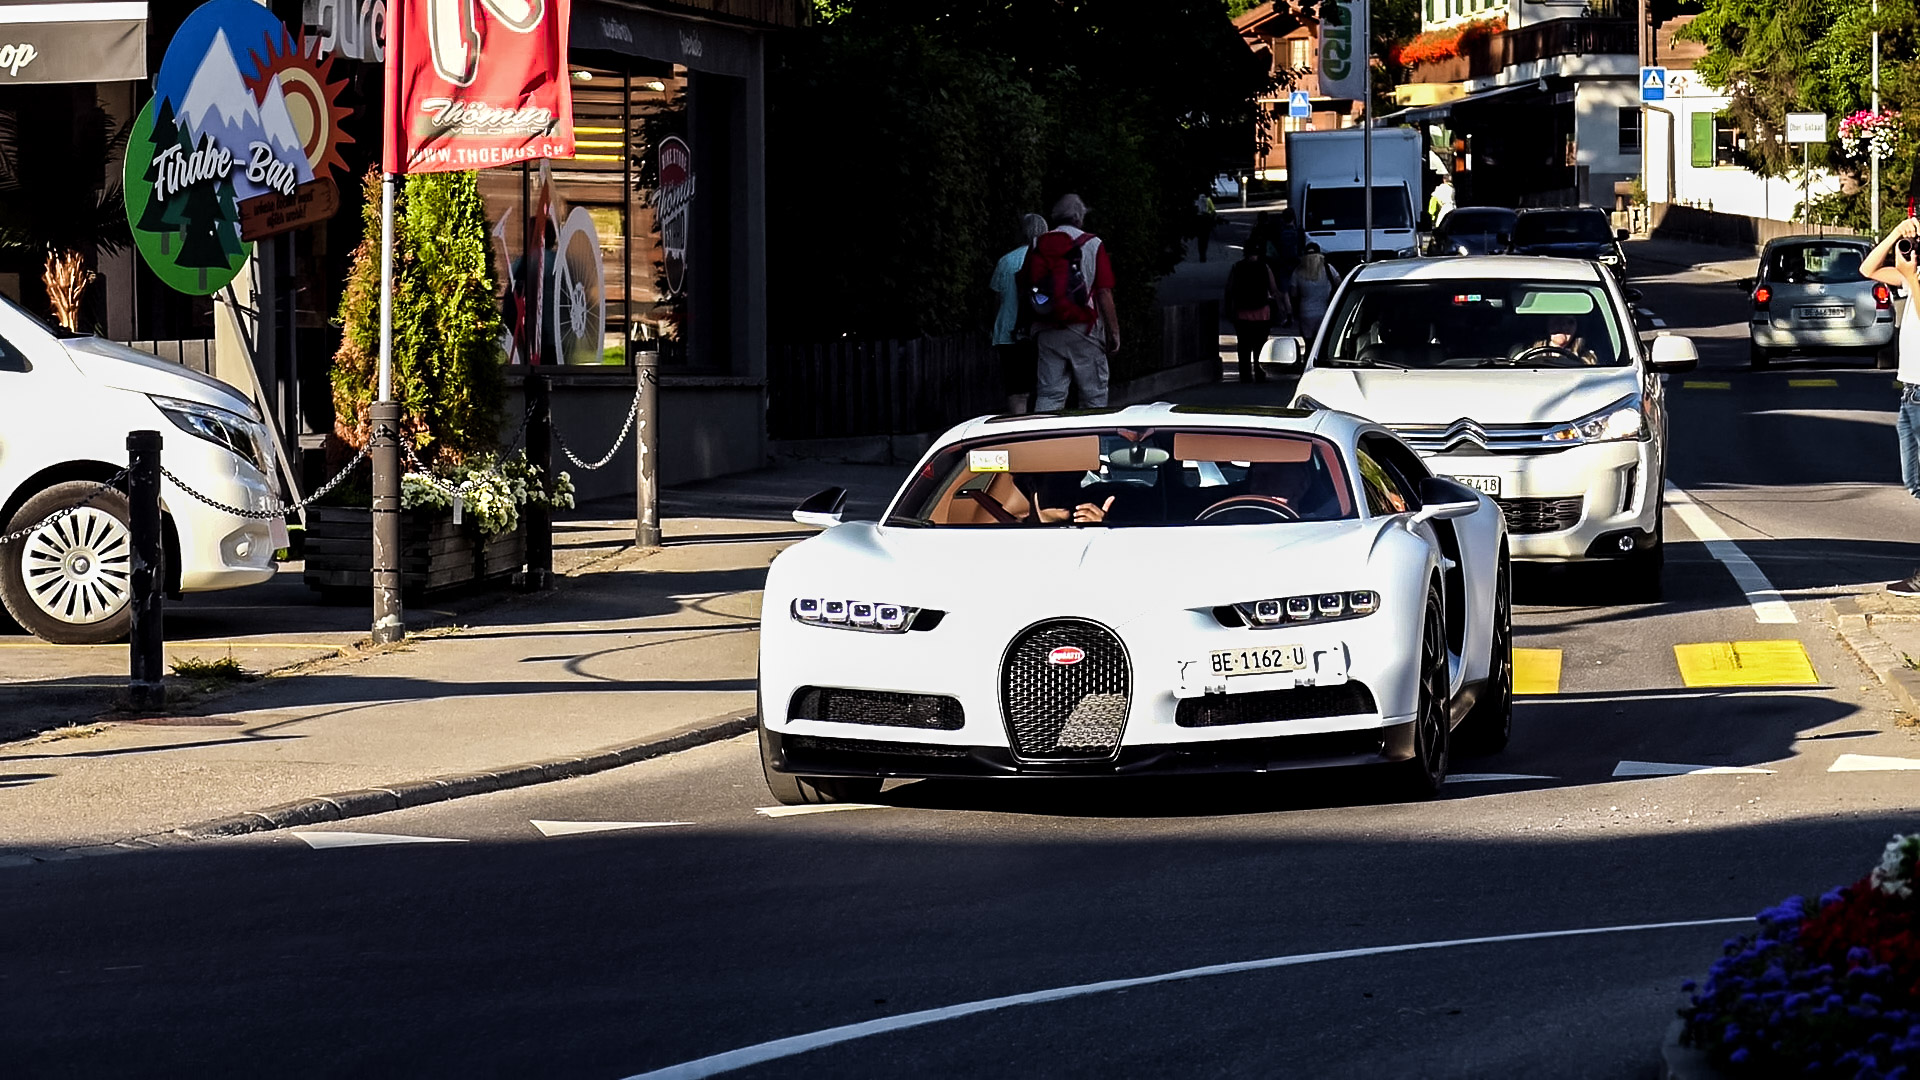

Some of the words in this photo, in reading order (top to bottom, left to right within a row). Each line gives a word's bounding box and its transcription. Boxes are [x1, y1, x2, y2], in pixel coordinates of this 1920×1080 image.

[0, 43, 38, 77] op
[421, 97, 552, 127] Thömus
[409, 144, 564, 164] WWW.THOEMUS.CH
